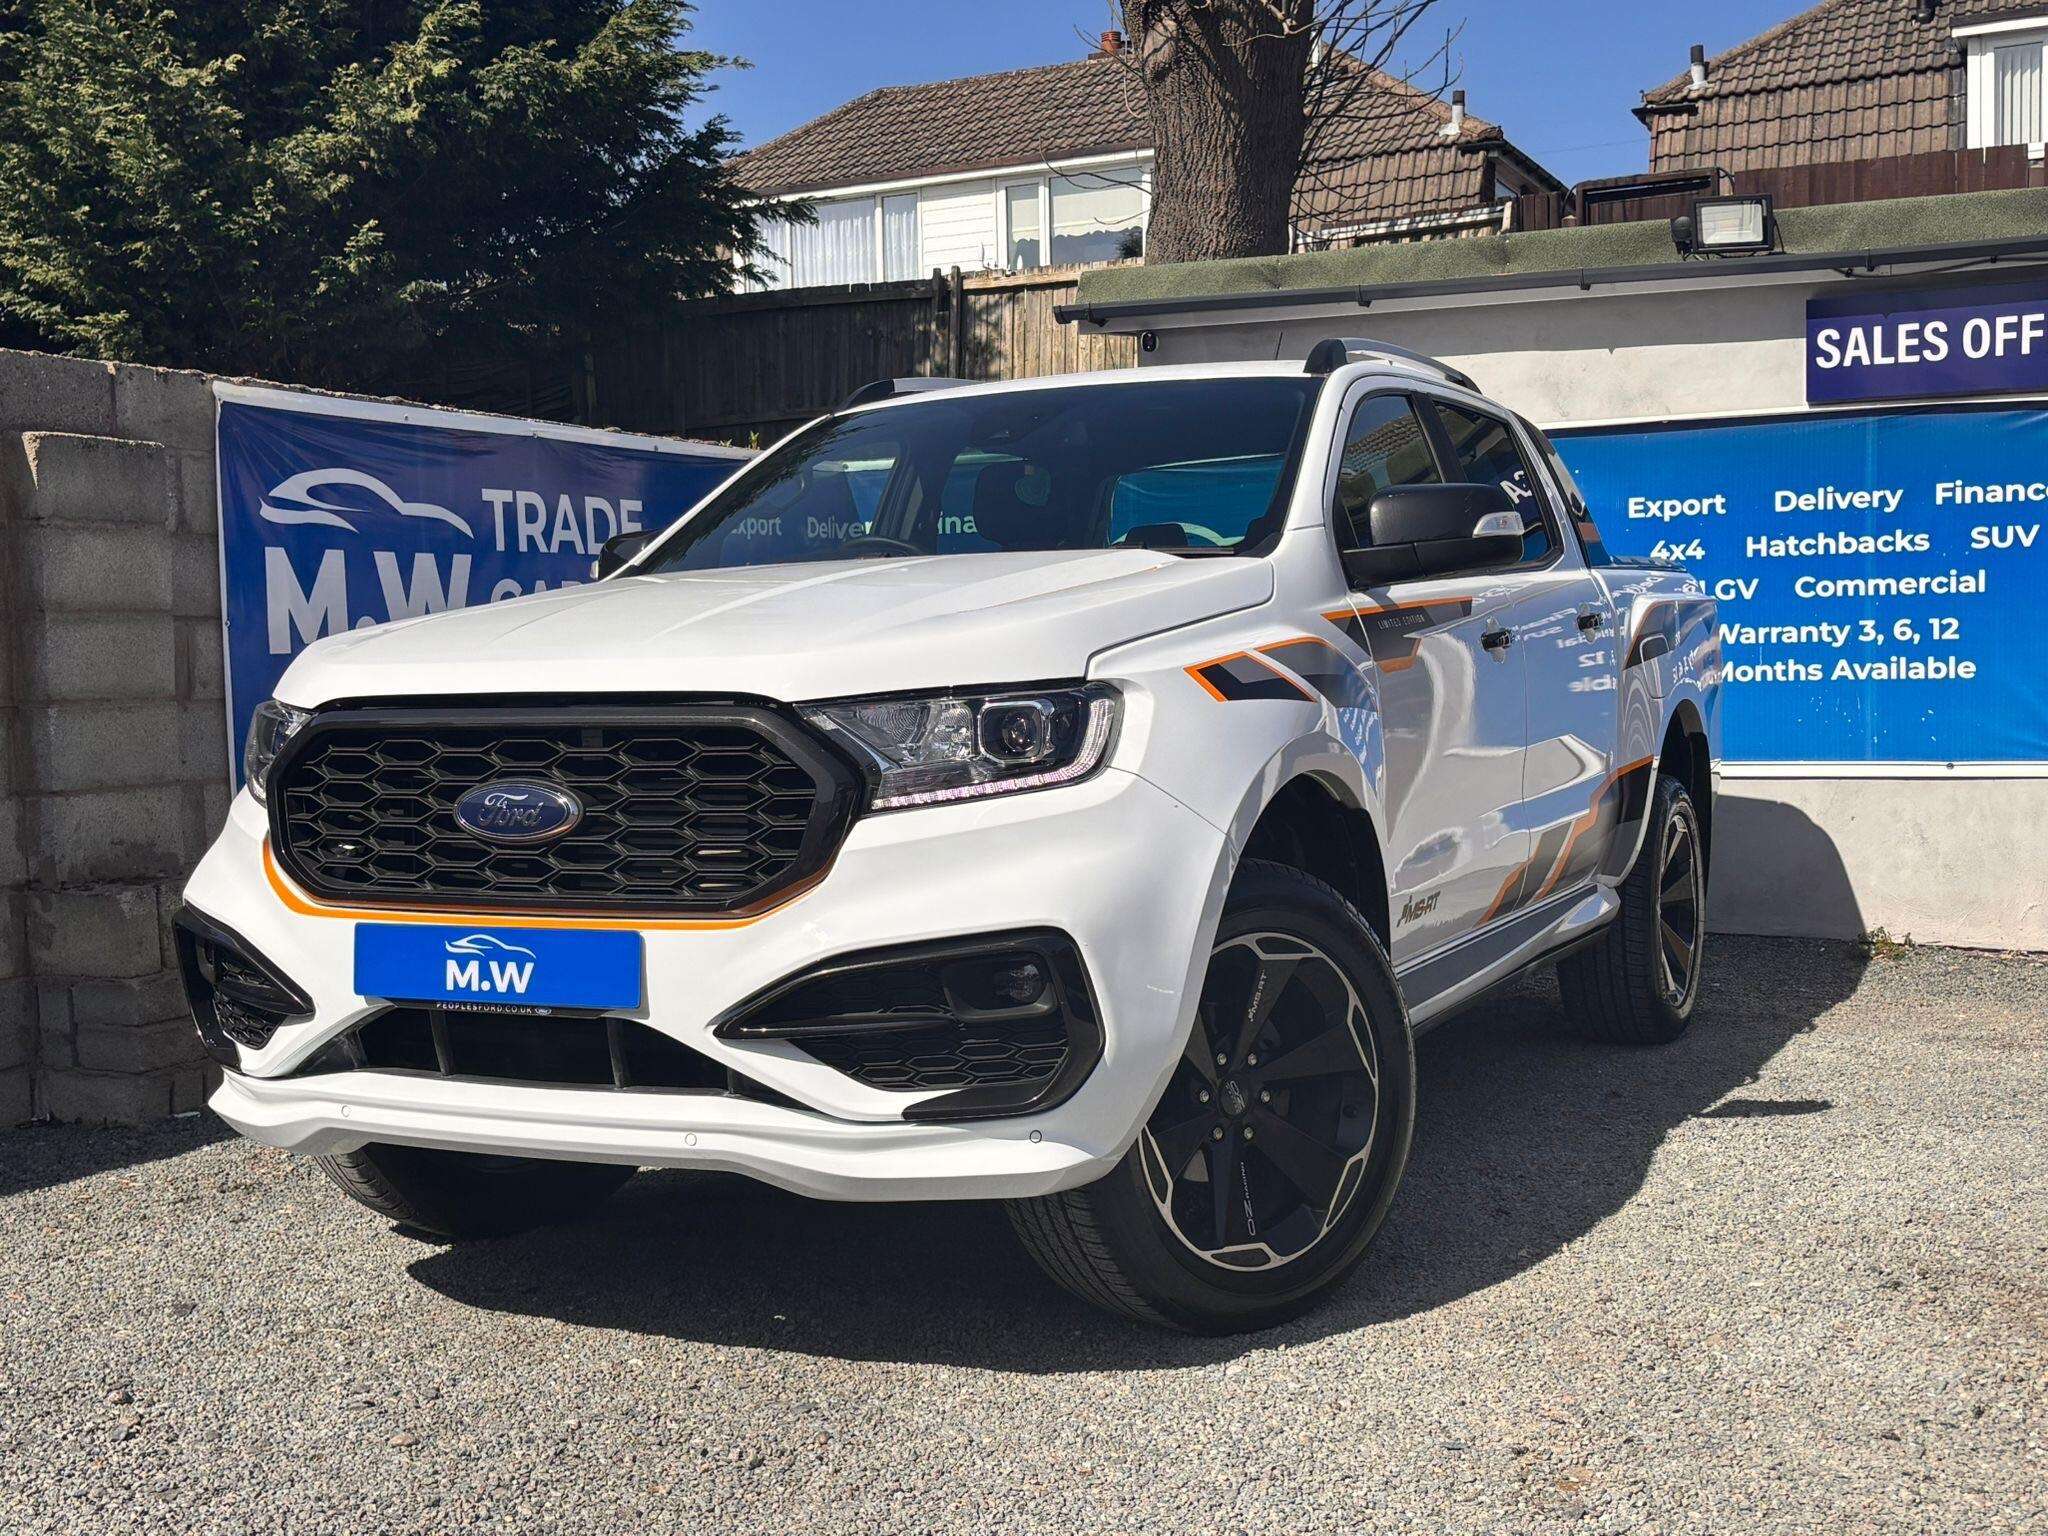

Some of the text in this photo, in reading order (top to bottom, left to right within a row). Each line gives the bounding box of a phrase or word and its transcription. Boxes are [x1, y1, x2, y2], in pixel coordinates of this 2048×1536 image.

[1815, 313, 2045, 369] SALES OFF
[1628, 479, 2048, 522] Export Delivery Financ
[481, 488, 643, 555] TRADE
[731, 516, 782, 540] xport
[1650, 524, 2041, 561] 4x4 Hatchbacks SUV
[1794, 568, 1986, 599] Commercial
[1718, 617, 1960, 648] Warranty 3, 6, 12
[1830, 655, 1977, 681] Available
[479, 793, 544, 827] Ford
[445, 959, 535, 994] M.W
